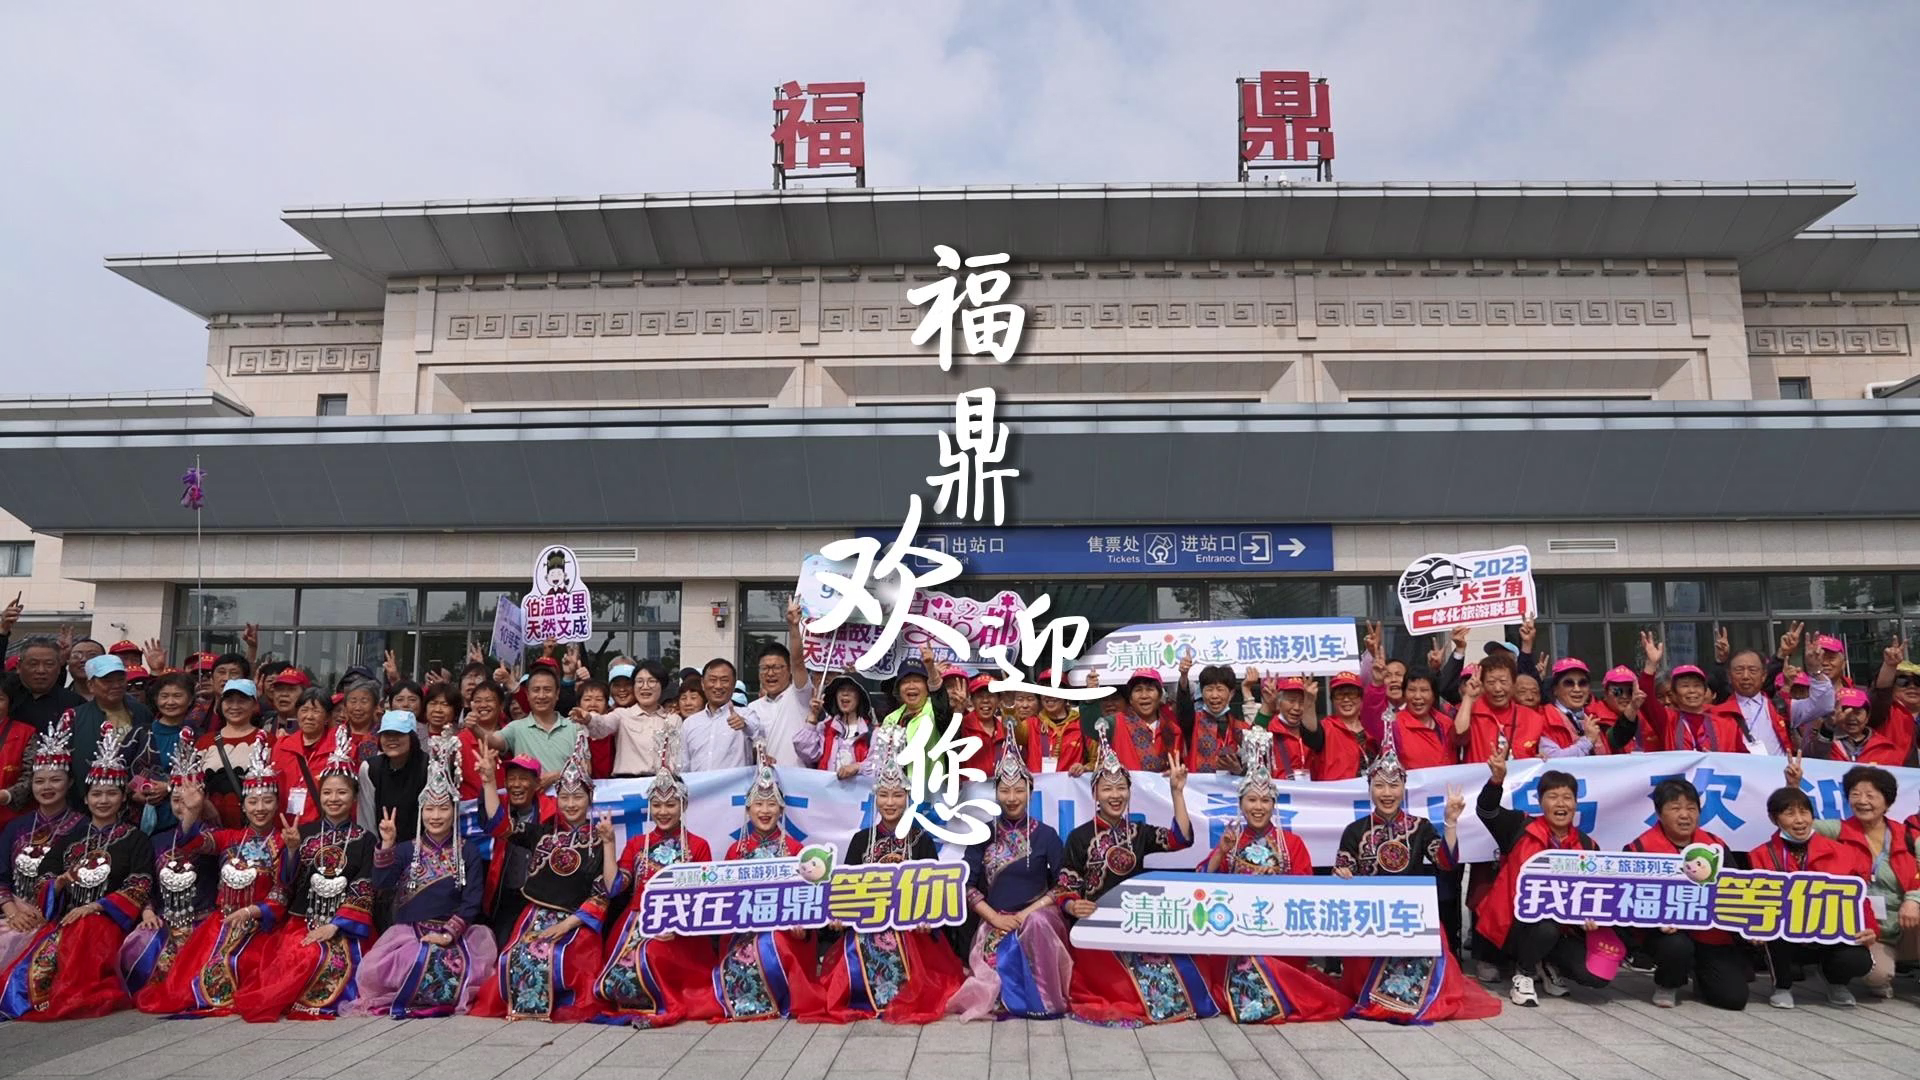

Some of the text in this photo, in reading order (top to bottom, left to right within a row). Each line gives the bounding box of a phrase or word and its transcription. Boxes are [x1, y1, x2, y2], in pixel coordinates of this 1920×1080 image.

[772, 71, 1334, 169] 福 鼎
[952, 535, 1236, 553] 出站口 售票处 进站口
[1108, 554, 1141, 563] Tickets
[1195, 554, 1236, 563] Entrance
[1473, 555, 1528, 578] 2023
[1460, 576, 1523, 603] 长三角
[526, 592, 587, 618] 伯温故里
[1418, 601, 1519, 625] 一体化旅游联盟
[526, 615, 588, 640] 天然文成
